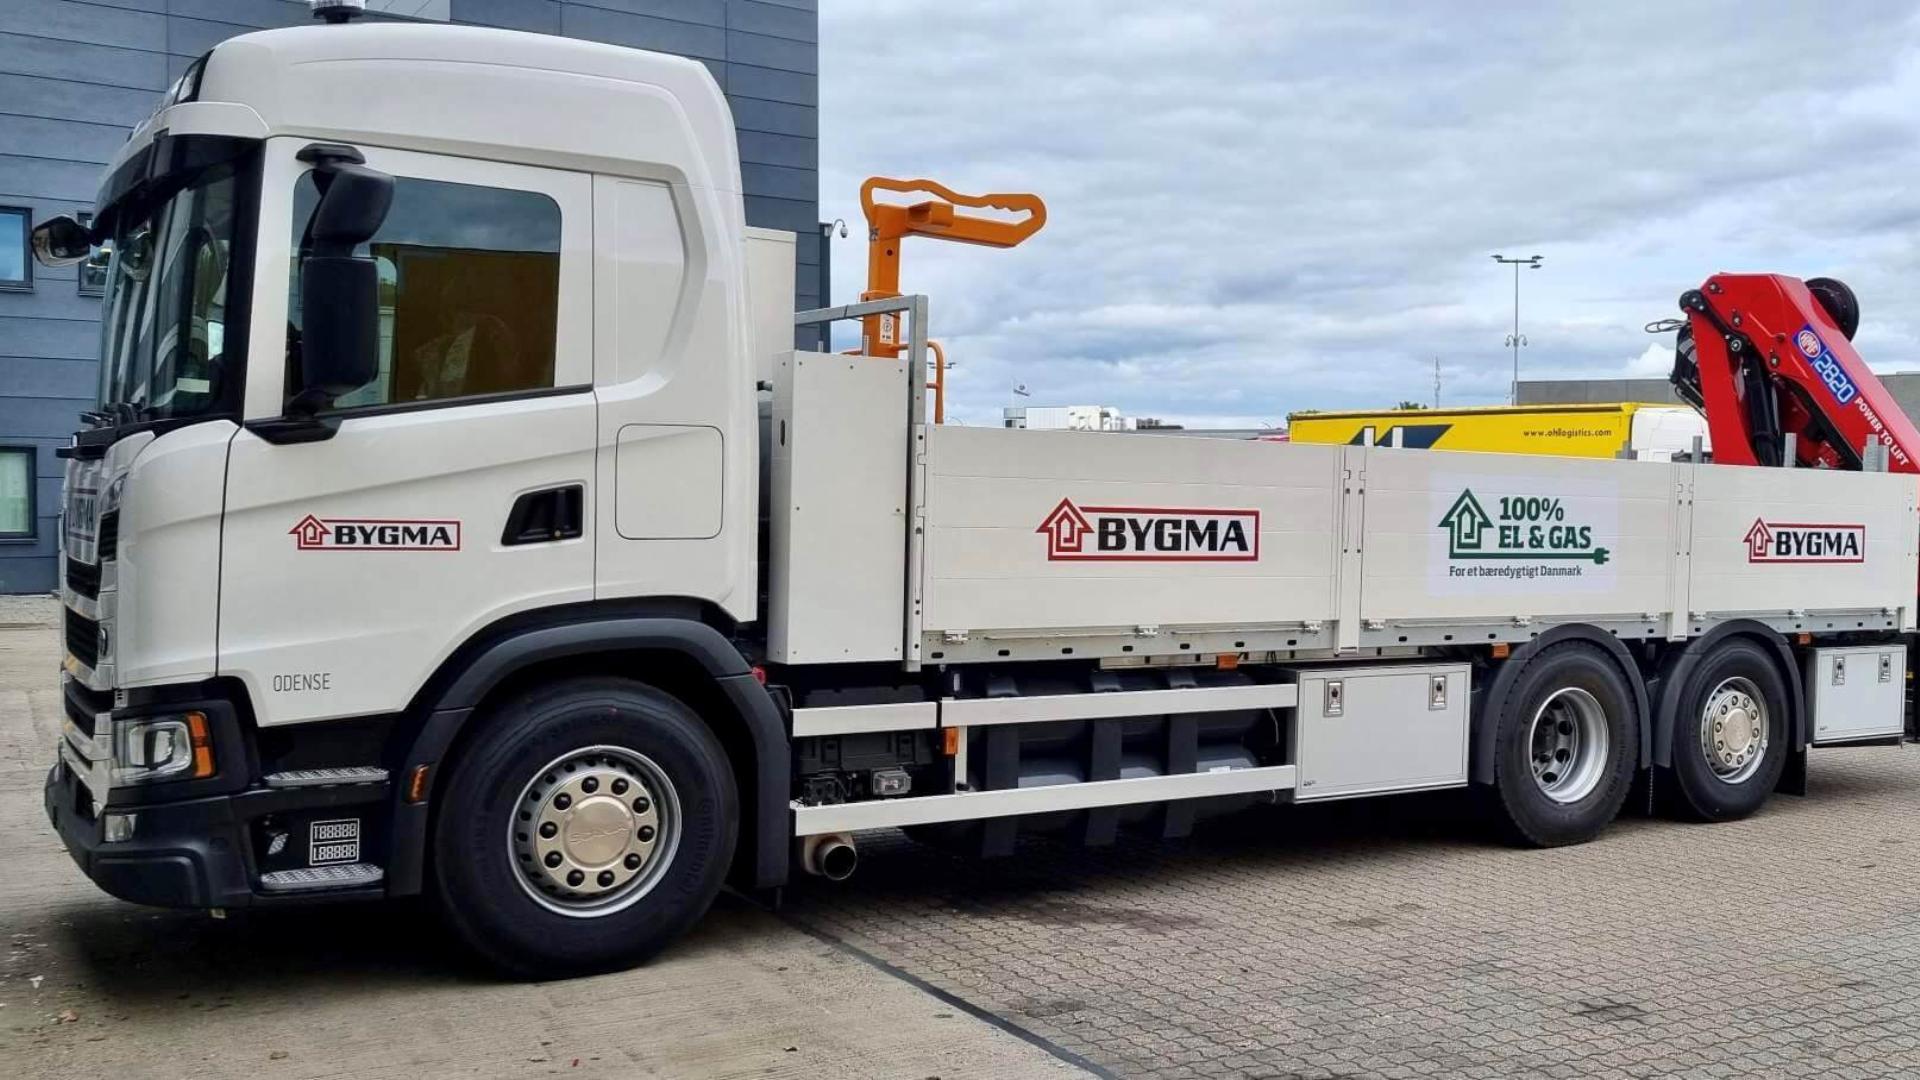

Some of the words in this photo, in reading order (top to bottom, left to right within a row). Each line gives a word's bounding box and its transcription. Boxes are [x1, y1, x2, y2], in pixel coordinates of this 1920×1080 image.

[1814, 353, 1855, 403] 2820
[1854, 396, 1883, 432] POWER
[1880, 427, 1893, 446] TO
[1889, 442, 1909, 466] LIFT
[1500, 497, 1564, 521] 100%
[335, 525, 452, 545] BYGMA
[1098, 518, 1248, 552] BYGMA
[1499, 525, 1524, 548] EL
[1528, 526, 1544, 548] &
[1549, 526, 1591, 549] GAS
[1776, 531, 1859, 556] BYGMA
[1449, 566, 1465, 576] For
[1467, 566, 1477, 576] et
[1479, 566, 1538, 579] bæredygtigt
[1540, 566, 1582, 576] Danmark
[273, 673, 331, 691] ODENSE
